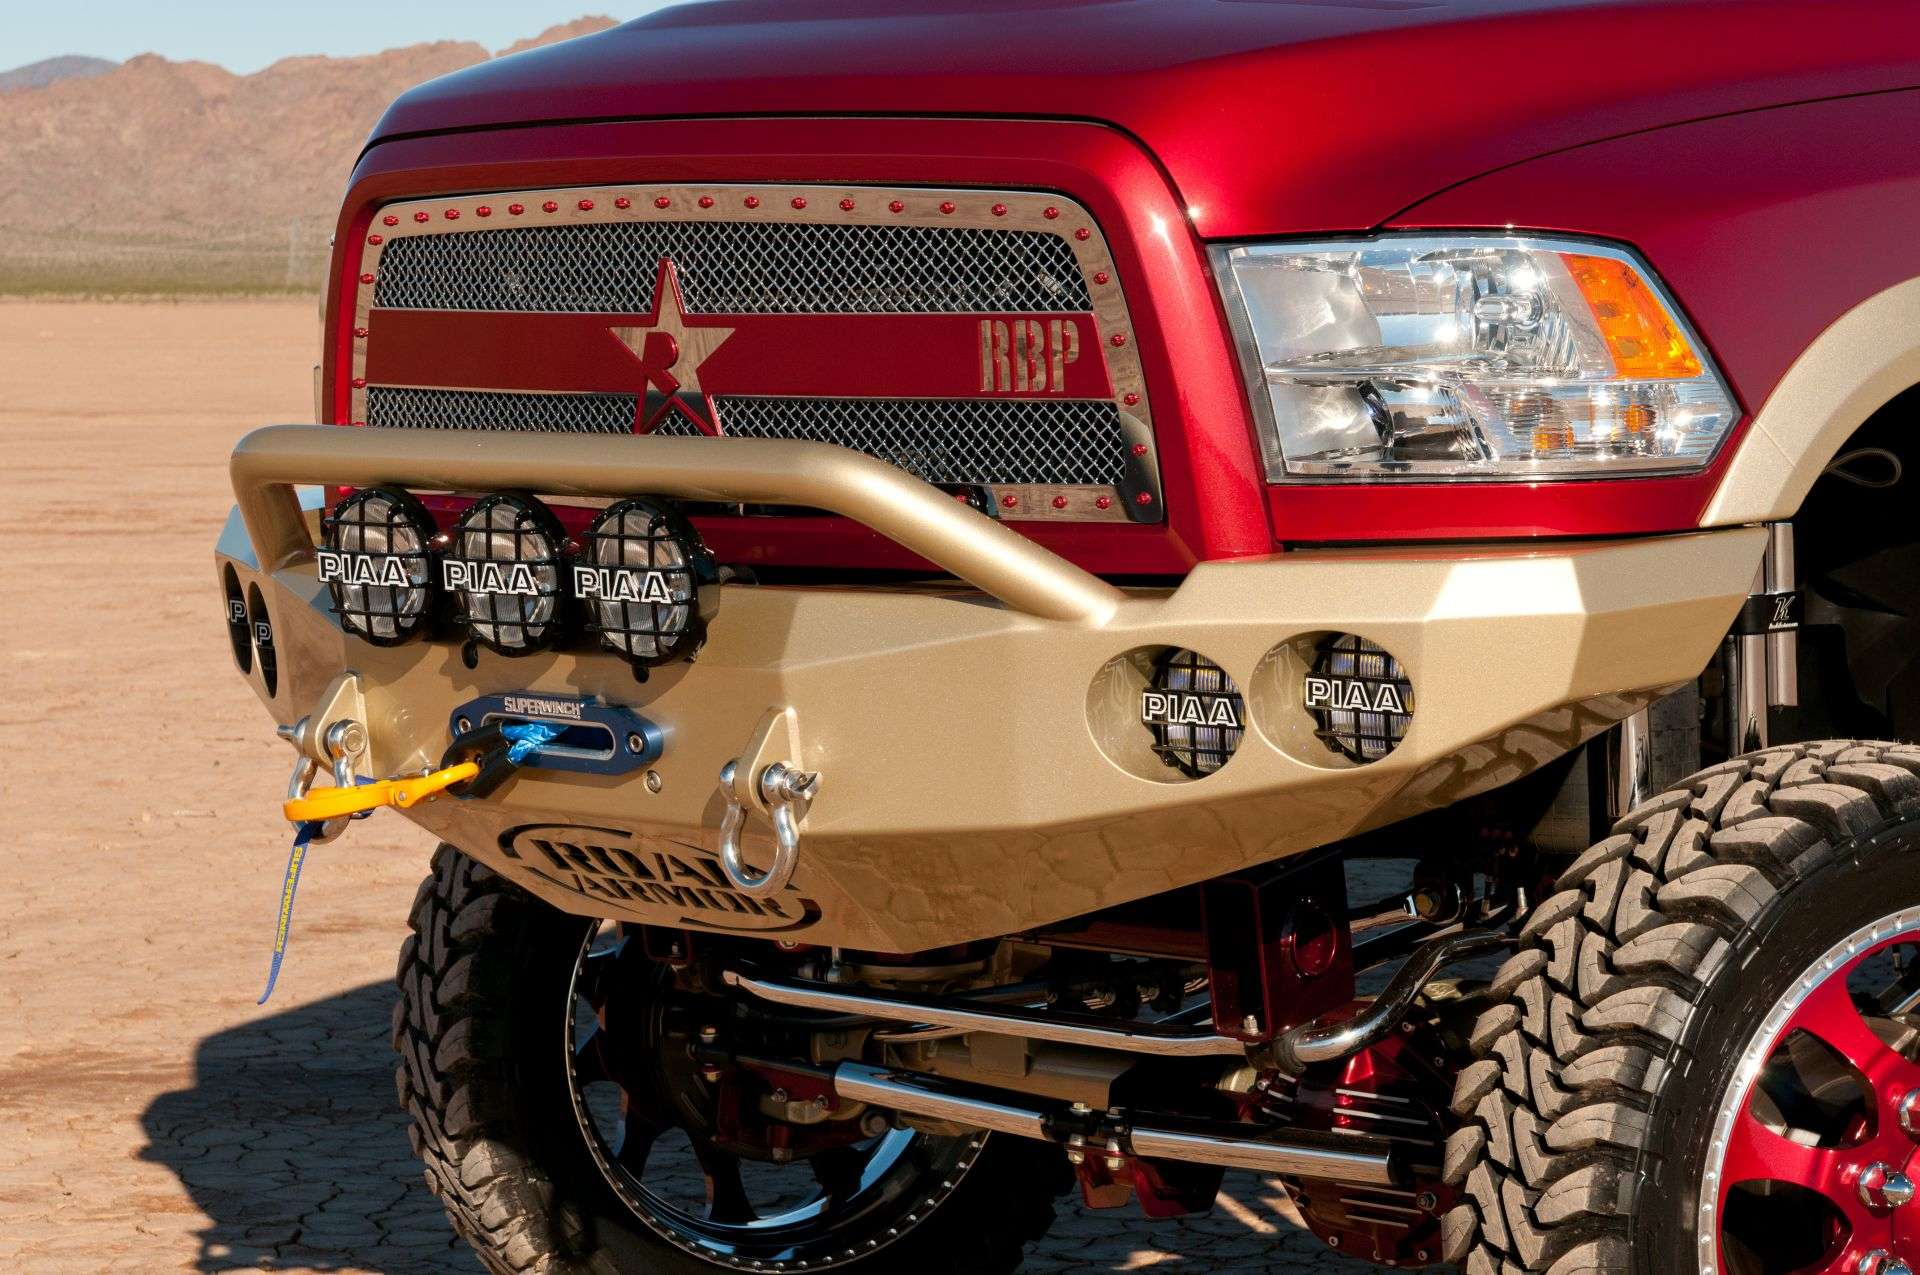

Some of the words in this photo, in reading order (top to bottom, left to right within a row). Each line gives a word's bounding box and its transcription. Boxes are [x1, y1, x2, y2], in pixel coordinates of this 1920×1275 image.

[978, 319, 1079, 392] RBP
[317, 551, 410, 588] PIAA
[442, 559, 539, 596] PIAA
[573, 566, 672, 604] PIAA
[504, 696, 581, 717] SUPERWINCH
[1142, 692, 1238, 727] PIAA
[1304, 677, 1404, 713] PIAA
[571, 872, 794, 919] ARMOR
